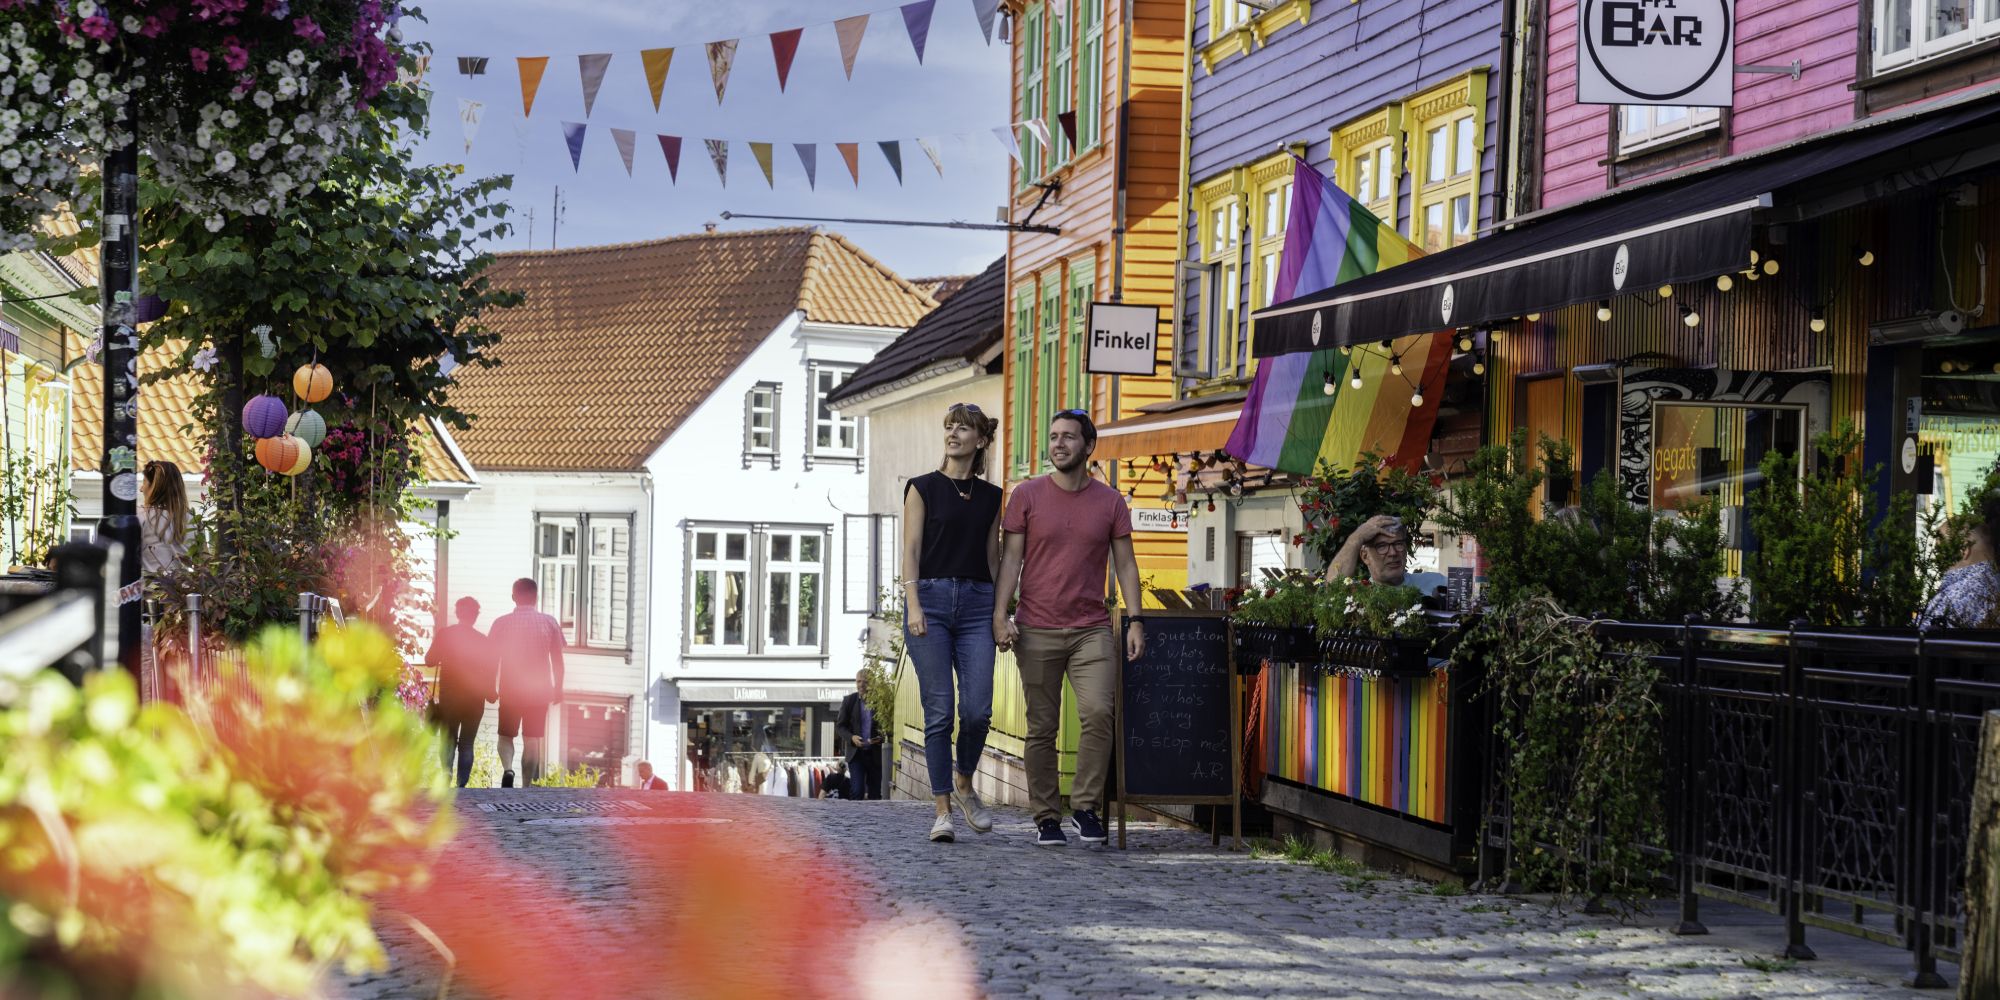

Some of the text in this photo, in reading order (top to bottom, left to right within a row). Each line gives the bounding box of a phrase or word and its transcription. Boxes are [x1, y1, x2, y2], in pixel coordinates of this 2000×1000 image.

[1602, 2, 1702, 47] BAR
[1094, 329, 1150, 350] Finkel
[1157, 625, 1225, 647] question
[1167, 643, 1204, 659] who's
[1130, 663, 1171, 680] going
[1145, 709, 1191, 729] going
[1128, 727, 1145, 747] to
[1151, 731, 1191, 755] stop
